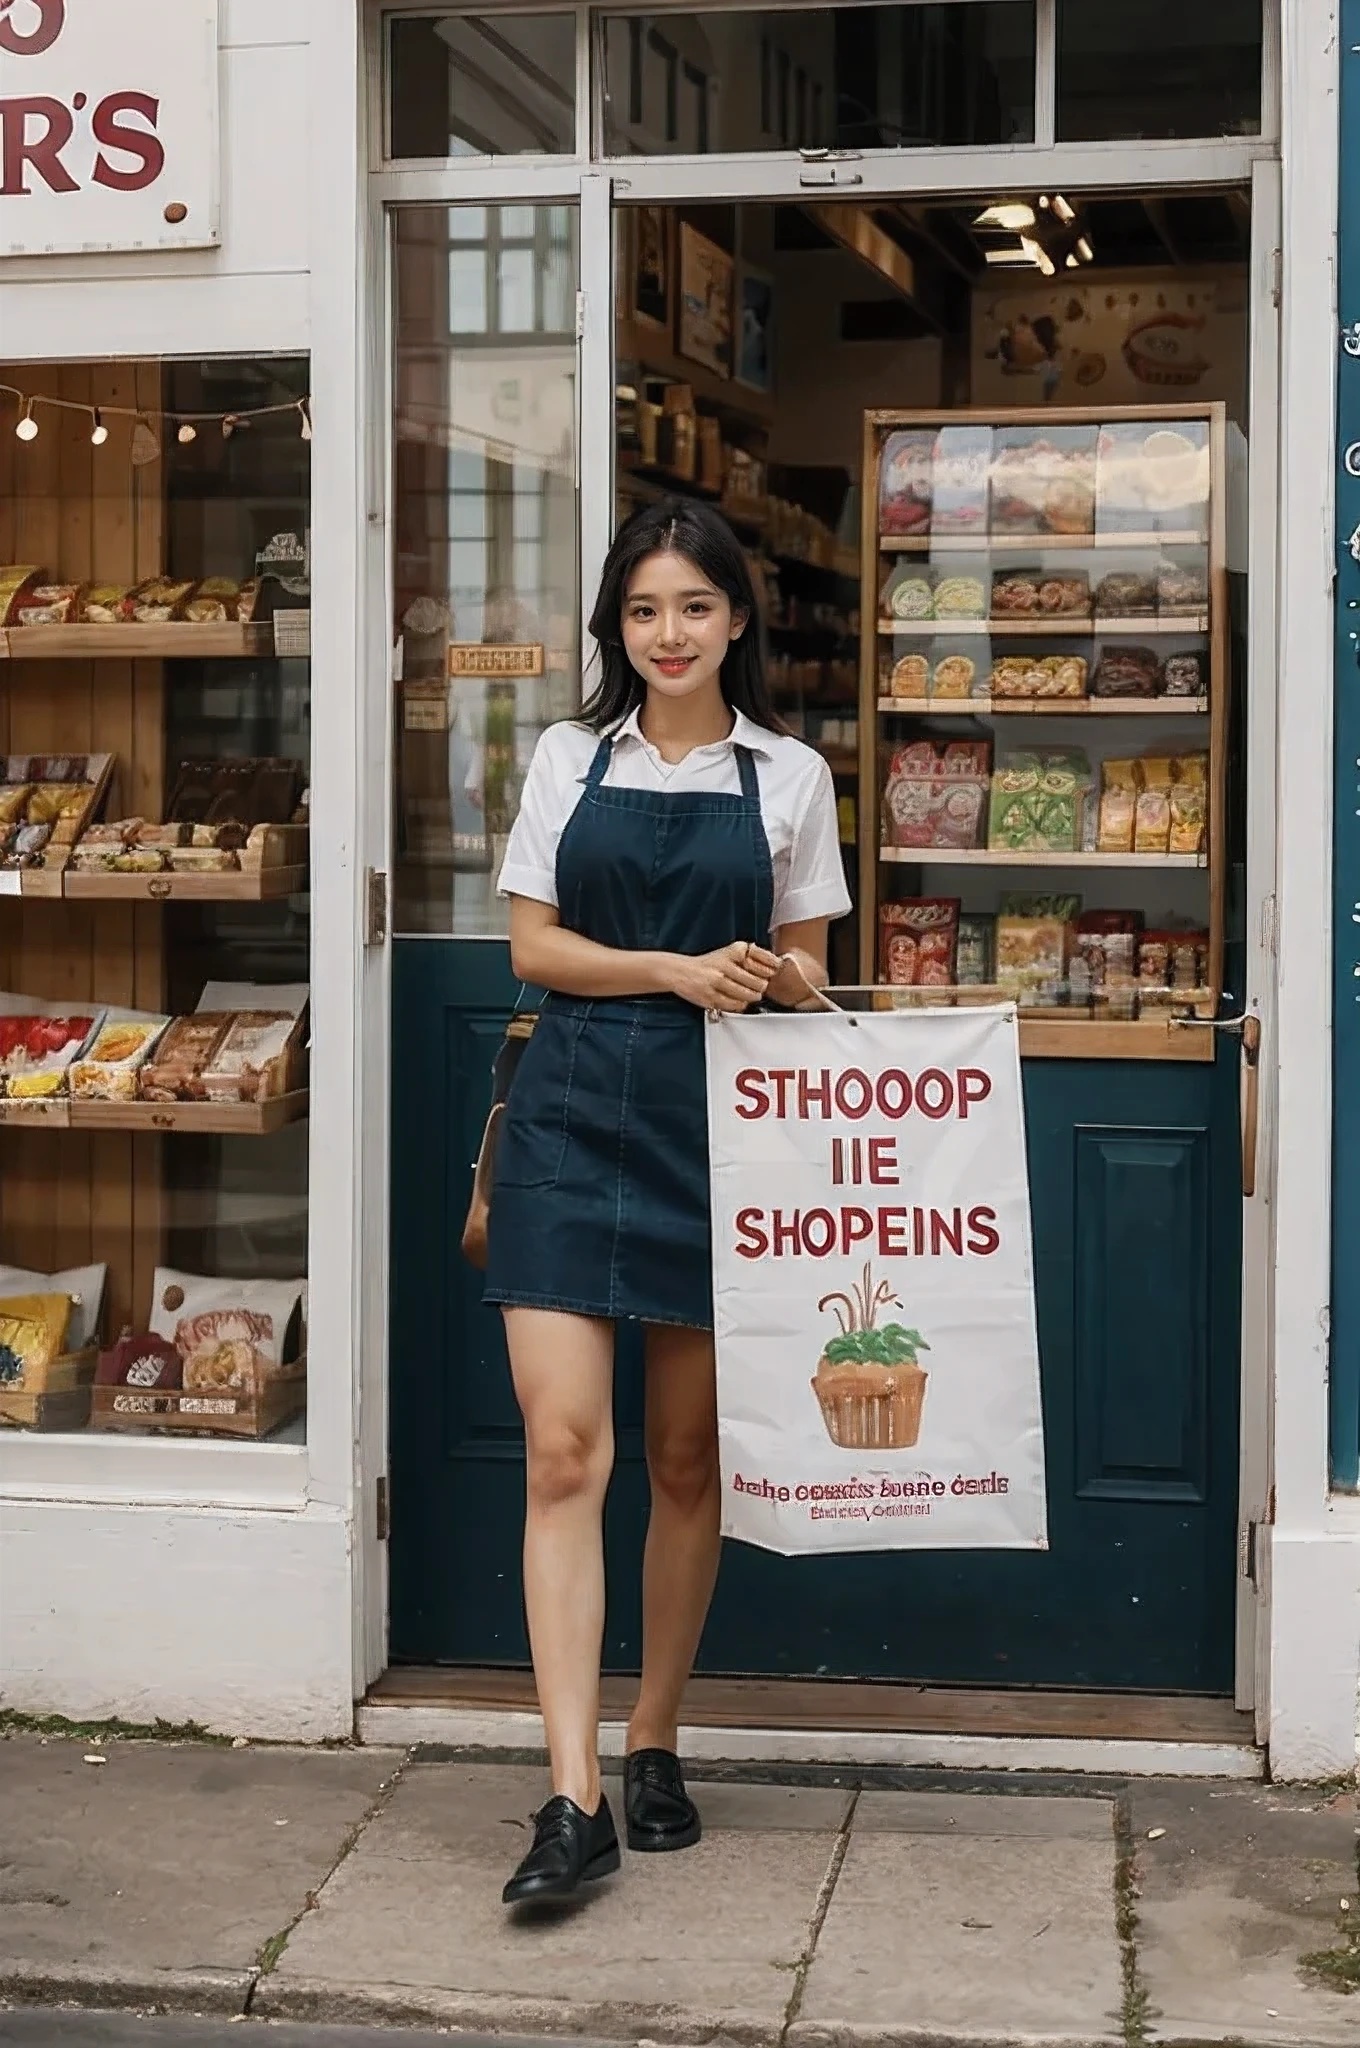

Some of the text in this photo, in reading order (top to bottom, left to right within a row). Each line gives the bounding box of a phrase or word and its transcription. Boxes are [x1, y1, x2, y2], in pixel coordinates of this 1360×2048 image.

[735, 1068, 992, 1120] STHOOOP
[832, 1137, 900, 1185] IIE
[735, 1206, 1000, 1258] SHOPEINS
